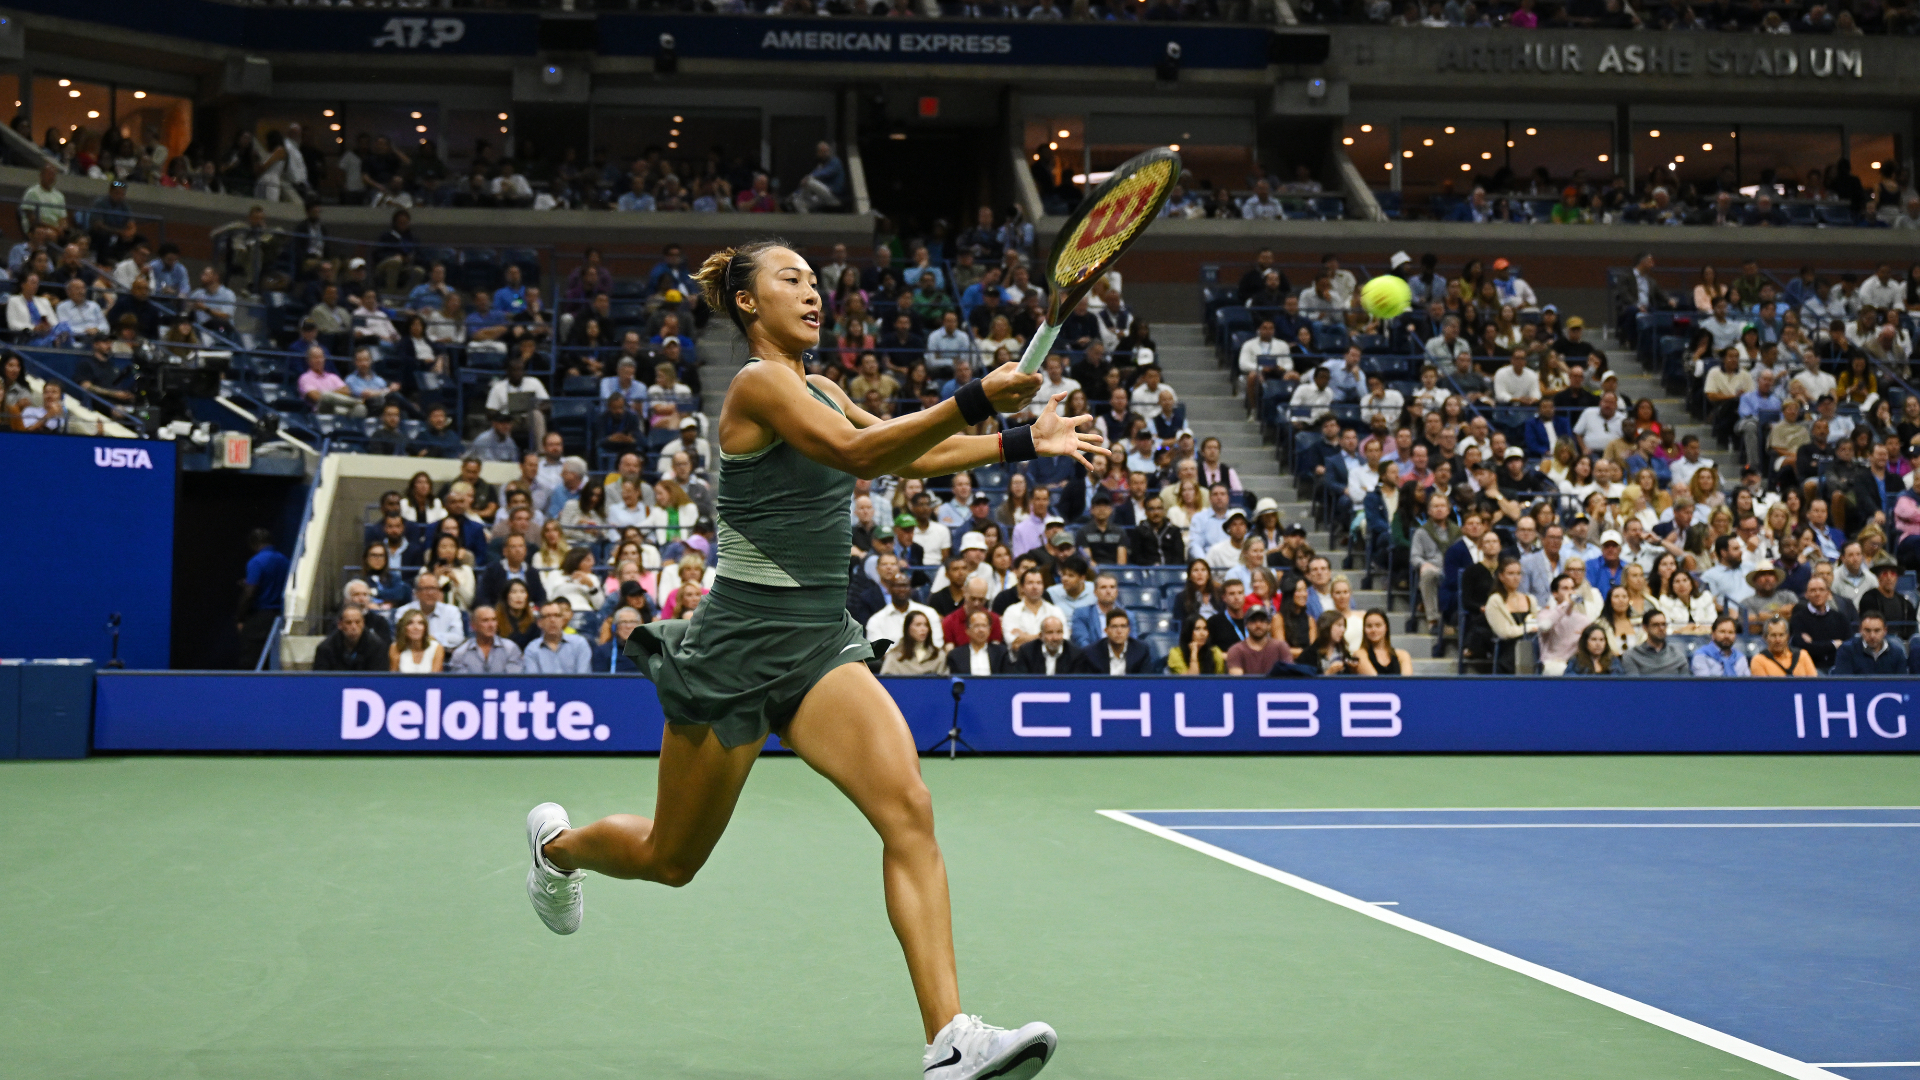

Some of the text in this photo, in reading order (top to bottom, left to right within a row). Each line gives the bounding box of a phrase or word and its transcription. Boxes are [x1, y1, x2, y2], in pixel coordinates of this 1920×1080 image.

[372, 18, 465, 48] ATP
[761, 30, 1012, 53] AMERICAN EXPRESS
[1598, 45, 1692, 74] ASHE
[94, 446, 153, 470] USTA
[227, 438, 249, 464] EXIT
[341, 688, 610, 741] Deloitte.
[1012, 692, 1402, 737] CHUBB
[1794, 692, 1907, 738] IHG
